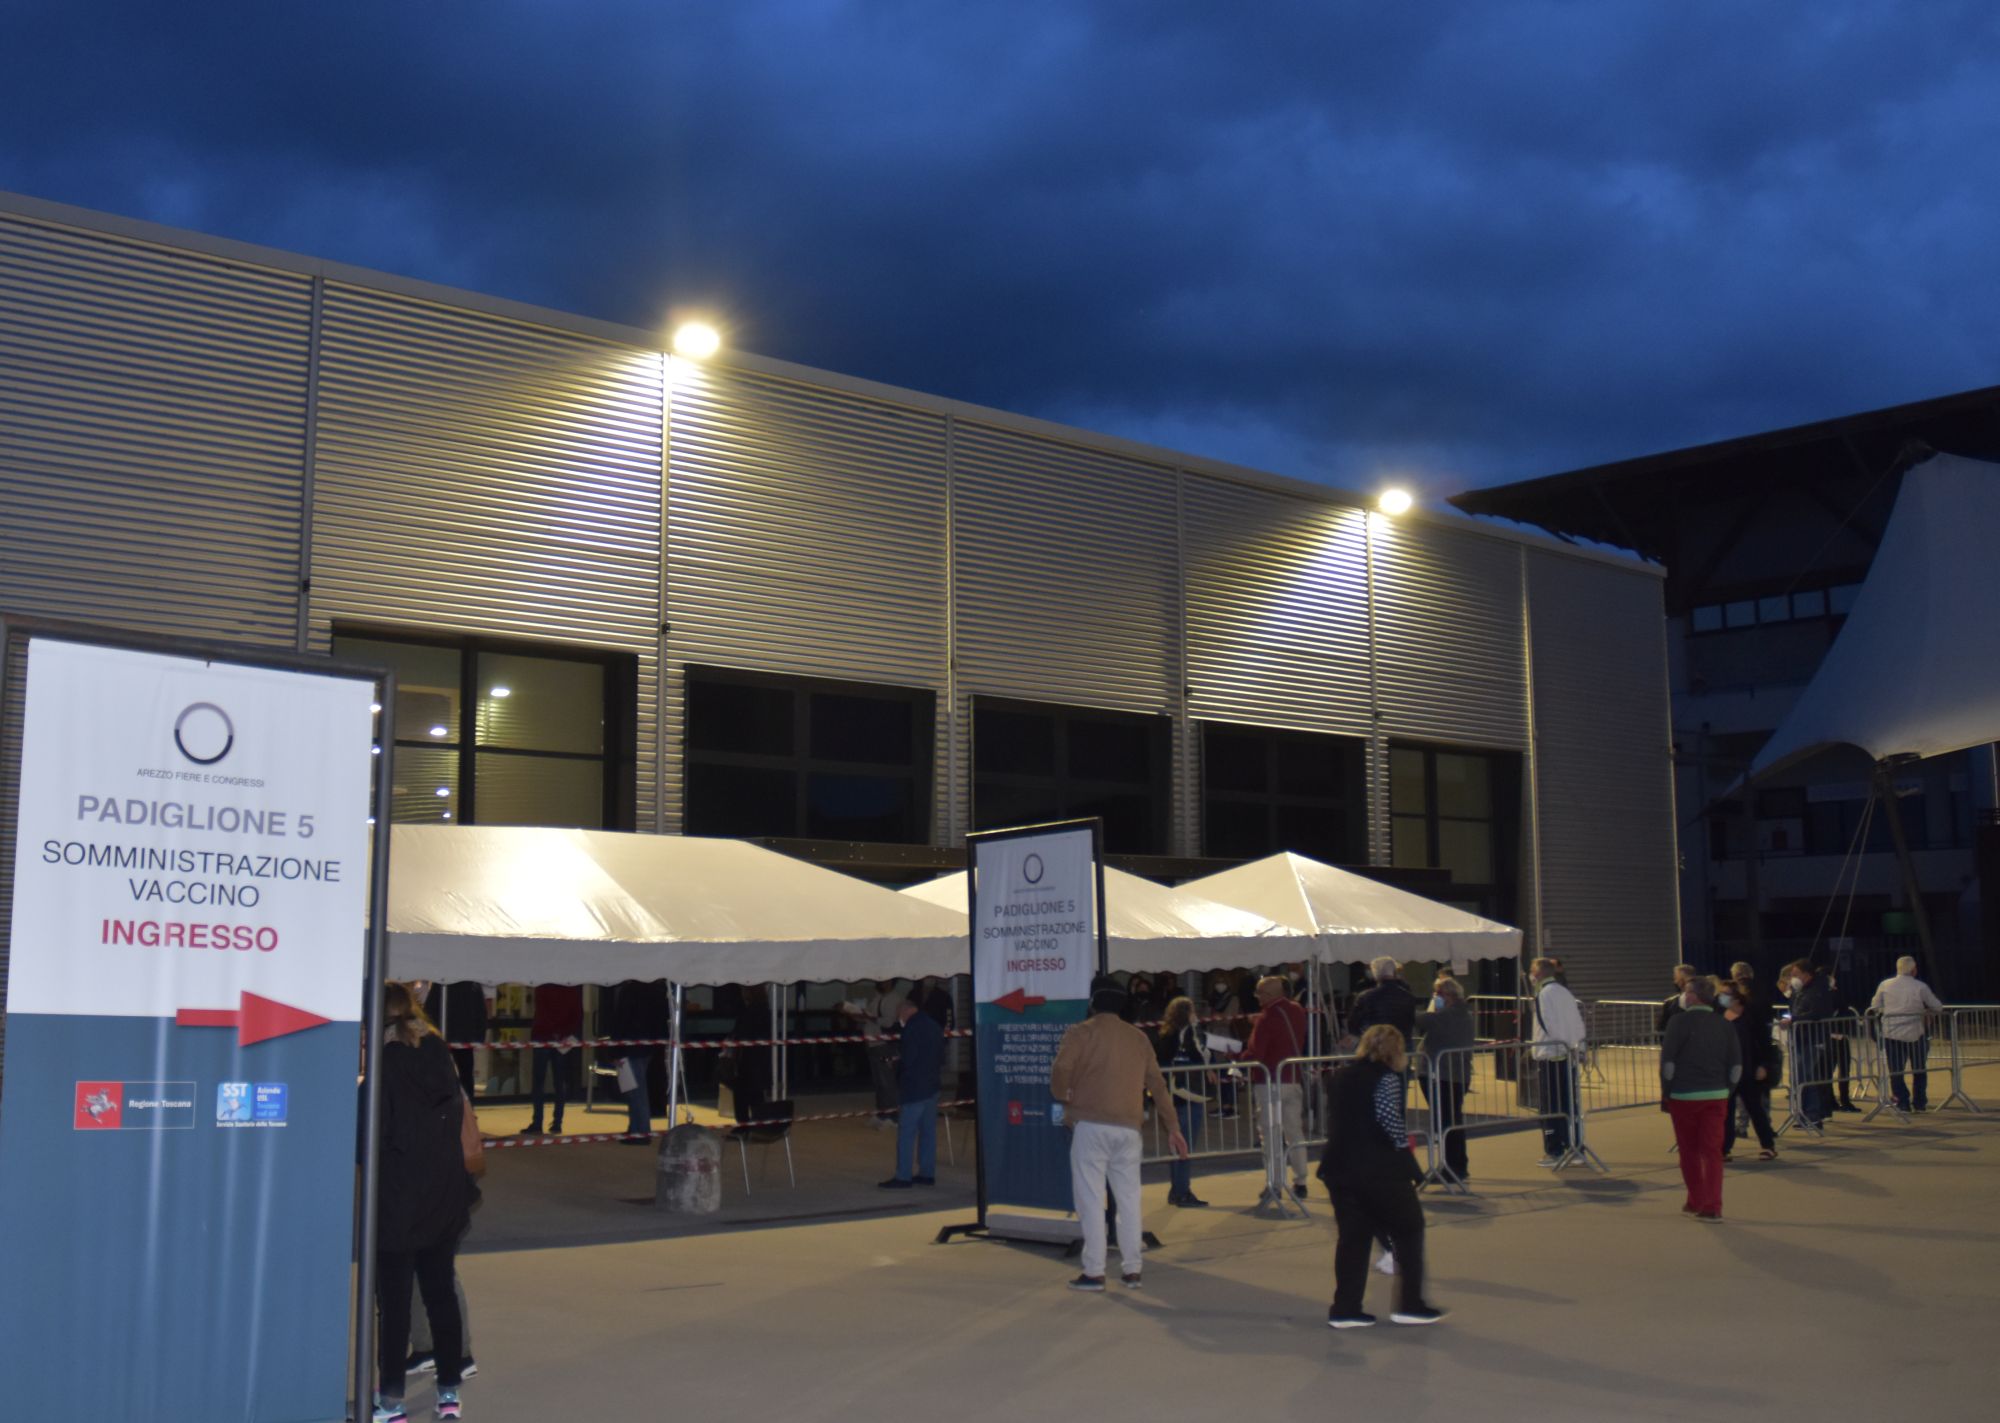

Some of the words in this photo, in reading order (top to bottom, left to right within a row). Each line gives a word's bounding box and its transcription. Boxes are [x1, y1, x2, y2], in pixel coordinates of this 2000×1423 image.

[136, 768, 174, 780] AREZZO
[175, 771, 202, 783] FIERE
[203, 774, 210, 784] E
[211, 775, 265, 788] CONGRESSI
[77, 794, 287, 837] PADIGLIONE
[297, 815, 315, 839] 5
[42, 840, 341, 883] SOMMINISTRAZIONE
[128, 878, 260, 908] VACCINO
[994, 900, 1065, 918] PADIGLIONE
[1068, 900, 1075, 913] 5
[101, 919, 278, 952] INGRESSO
[983, 921, 1087, 940] SOMMINISTRAZIONE
[1014, 938, 1059, 952] VACCINO
[1007, 958, 1067, 973] INGRESSO
[223, 1082, 249, 1097] SST
[128, 1100, 160, 1110] Regione
[161, 1100, 191, 1108] Toscana
